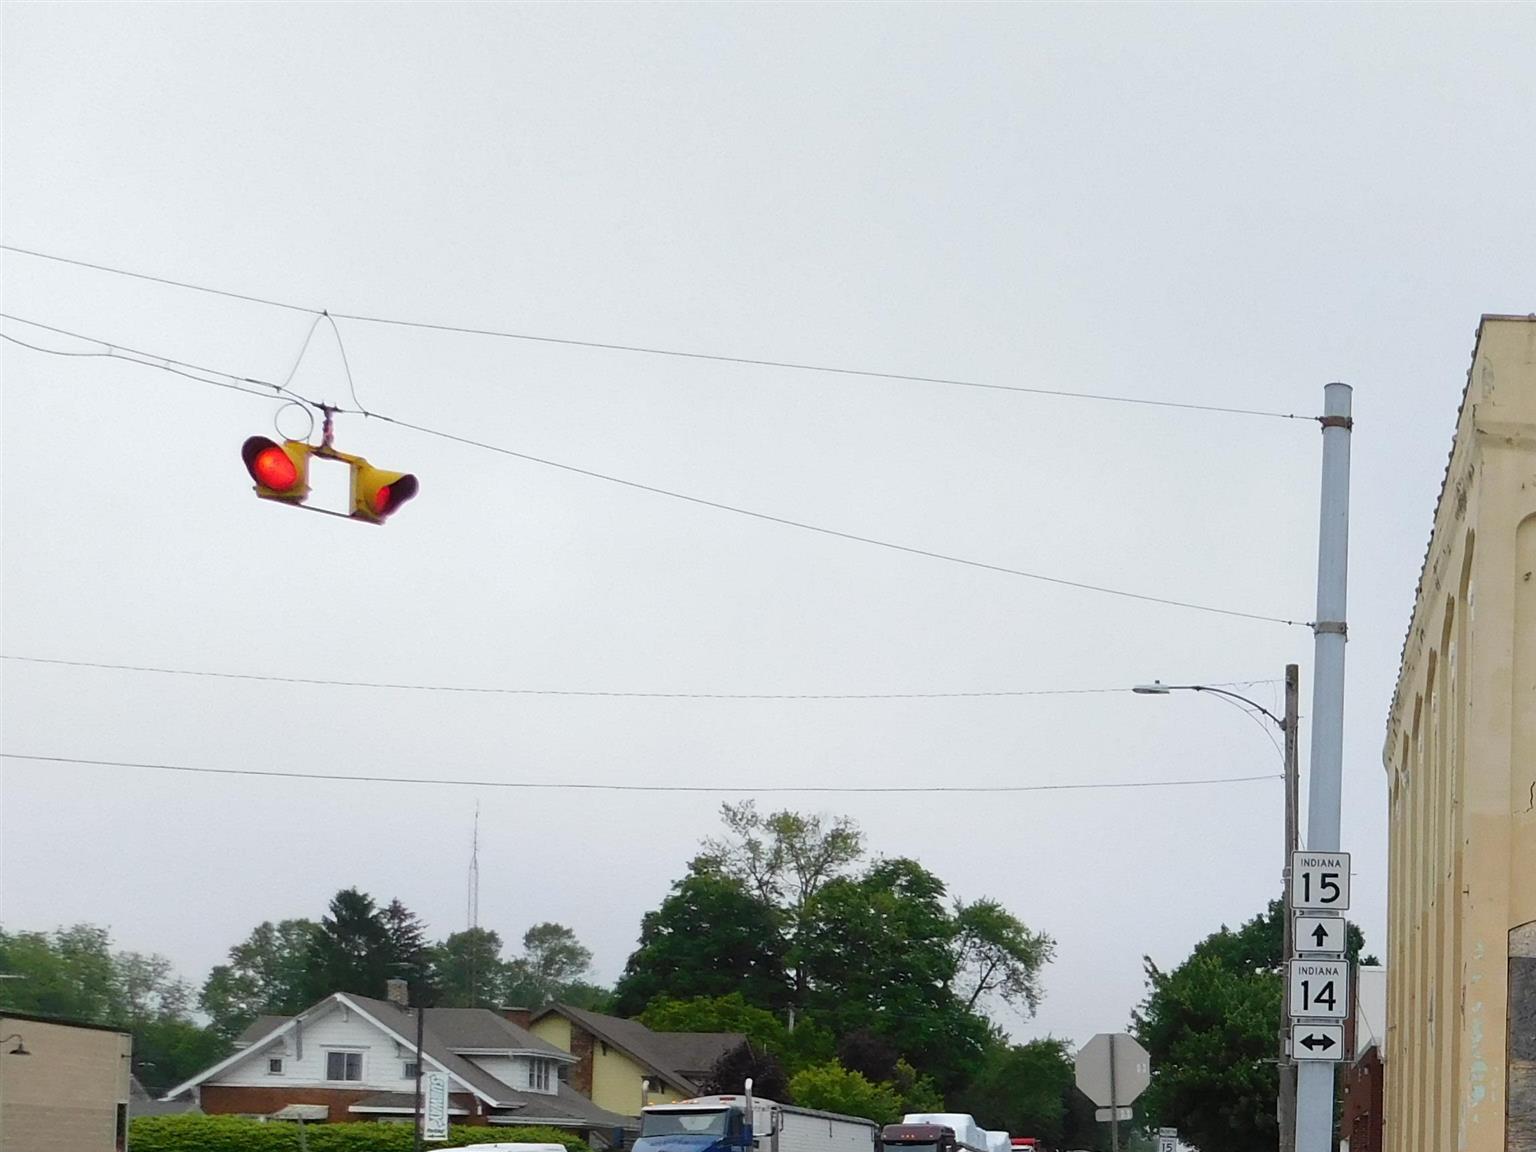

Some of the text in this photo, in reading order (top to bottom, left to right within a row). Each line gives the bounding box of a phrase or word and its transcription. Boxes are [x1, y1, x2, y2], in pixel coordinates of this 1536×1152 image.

[1301, 858, 1342, 868] INDIANA
[1302, 872, 1341, 903] 15
[1298, 966, 1340, 976] INDIANA
[1301, 980, 1336, 1012] 14
[1162, 1143, 1173, 1152] 15
